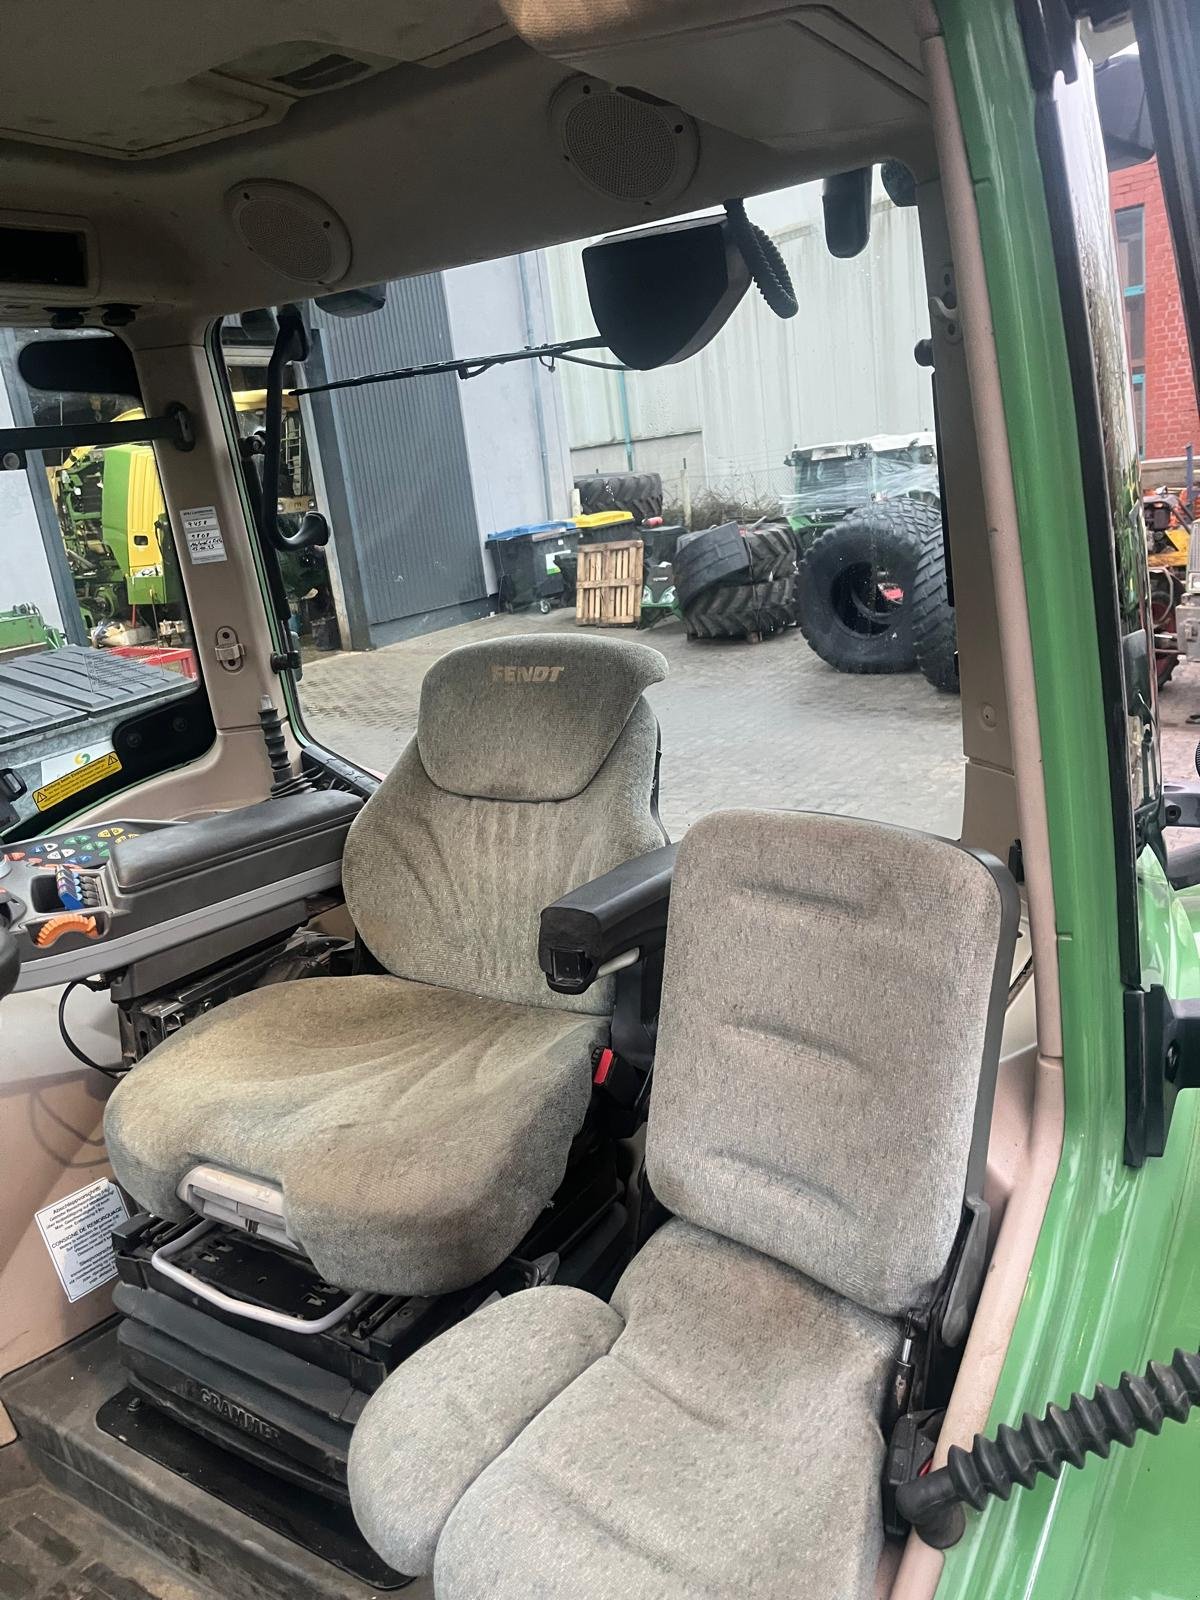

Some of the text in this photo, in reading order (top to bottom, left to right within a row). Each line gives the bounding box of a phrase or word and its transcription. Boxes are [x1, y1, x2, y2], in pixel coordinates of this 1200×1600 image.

[489, 666, 564, 682] FENDT
[51, 1230, 79, 1248] CONSIGNE
[86, 1205, 122, 1229] REMORQUAGE
